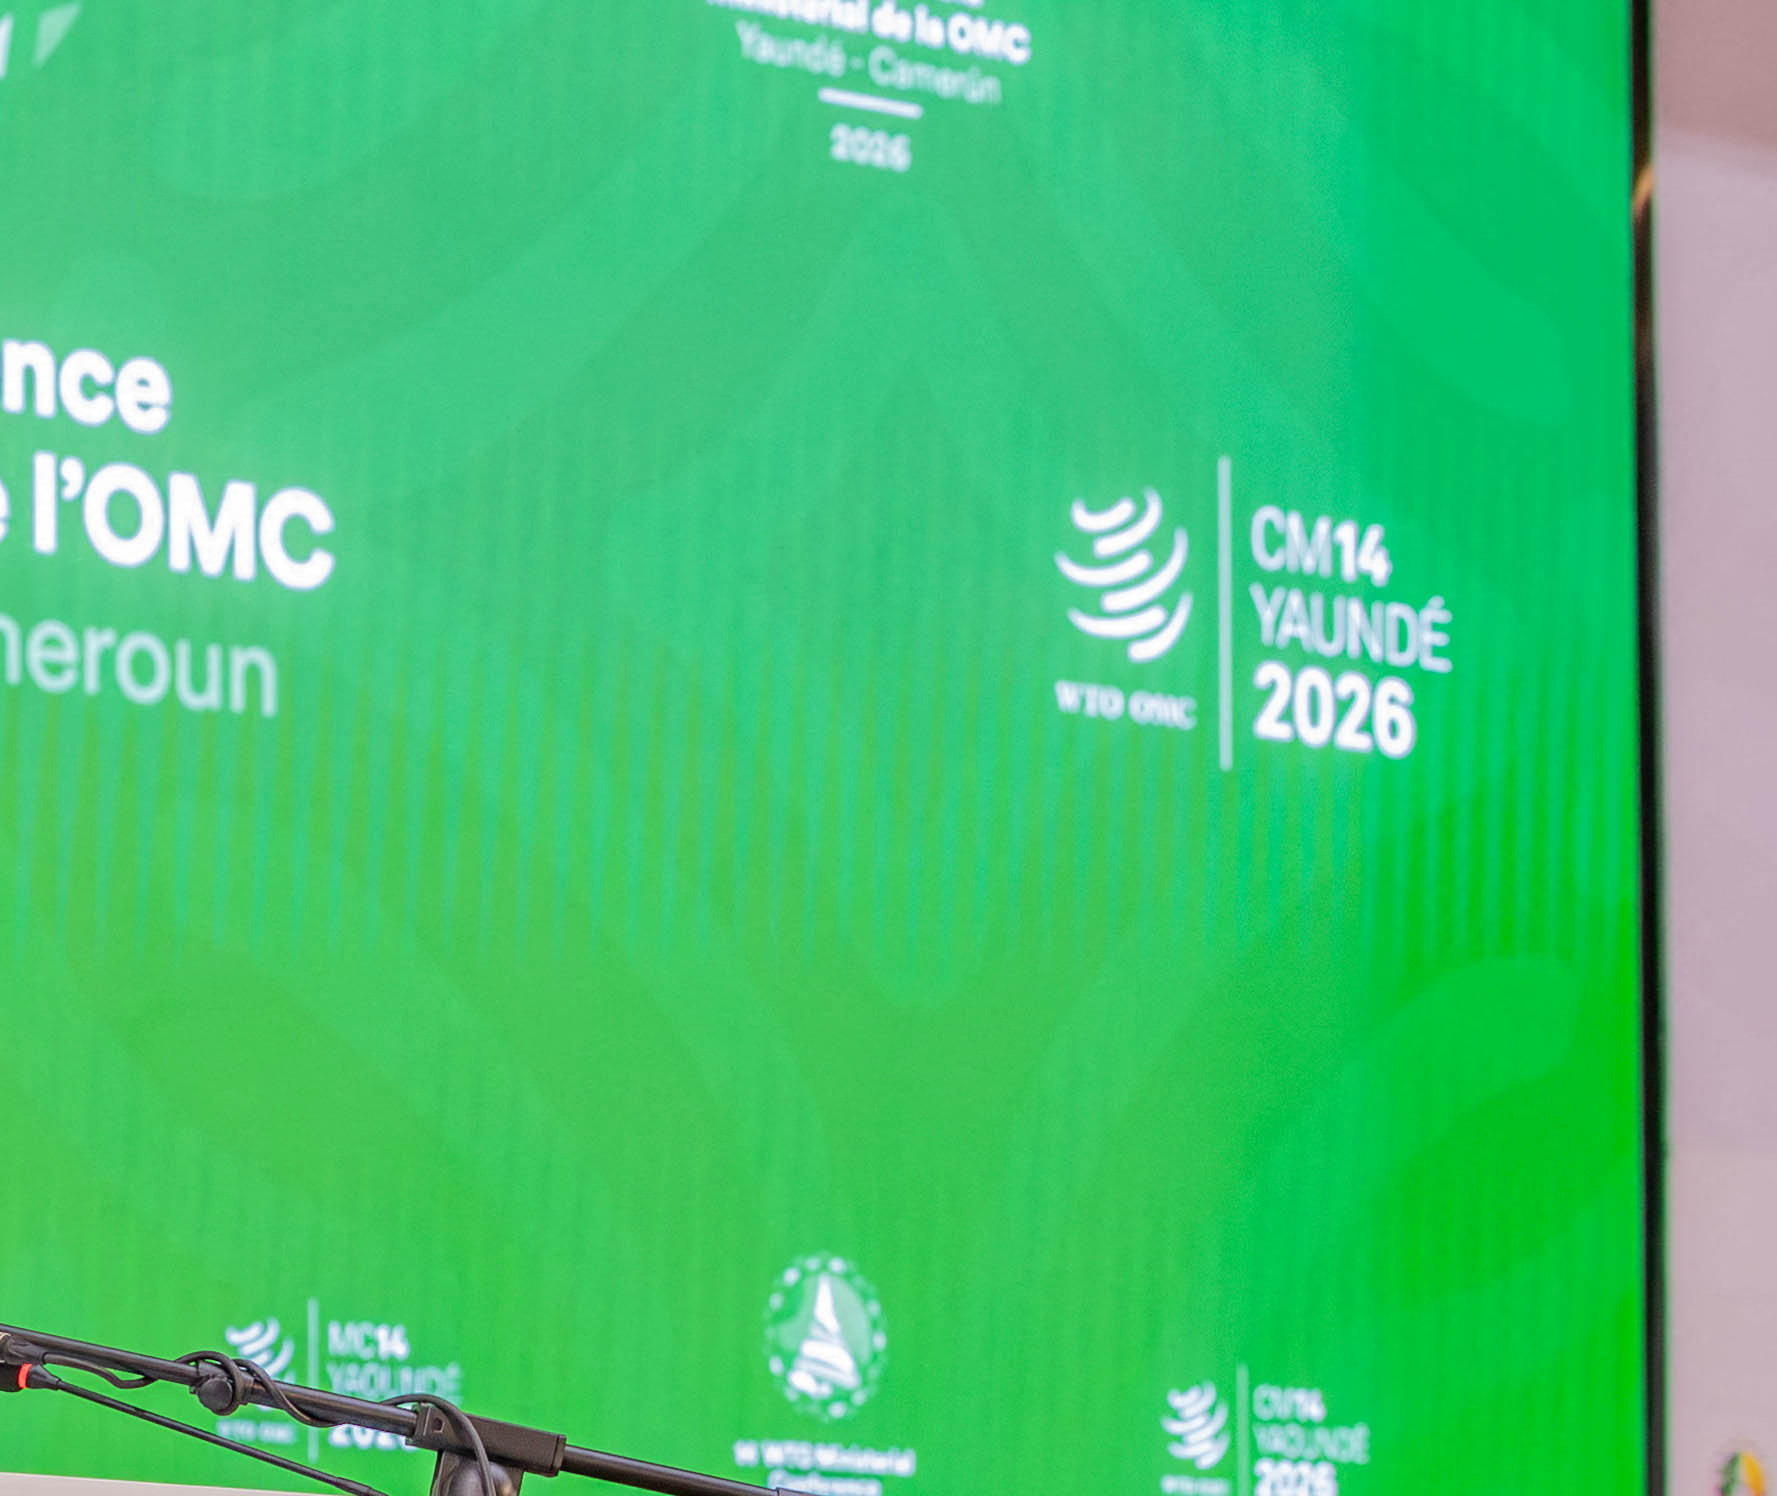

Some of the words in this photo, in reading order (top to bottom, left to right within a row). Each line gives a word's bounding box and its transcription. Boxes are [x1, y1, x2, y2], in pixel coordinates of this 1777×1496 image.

[947, 13, 1031, 65] OMC
[1250, 503, 1392, 588] CM14
[1249, 581, 1453, 675] YAUNDÉ
[1252, 660, 1419, 761] 2026
